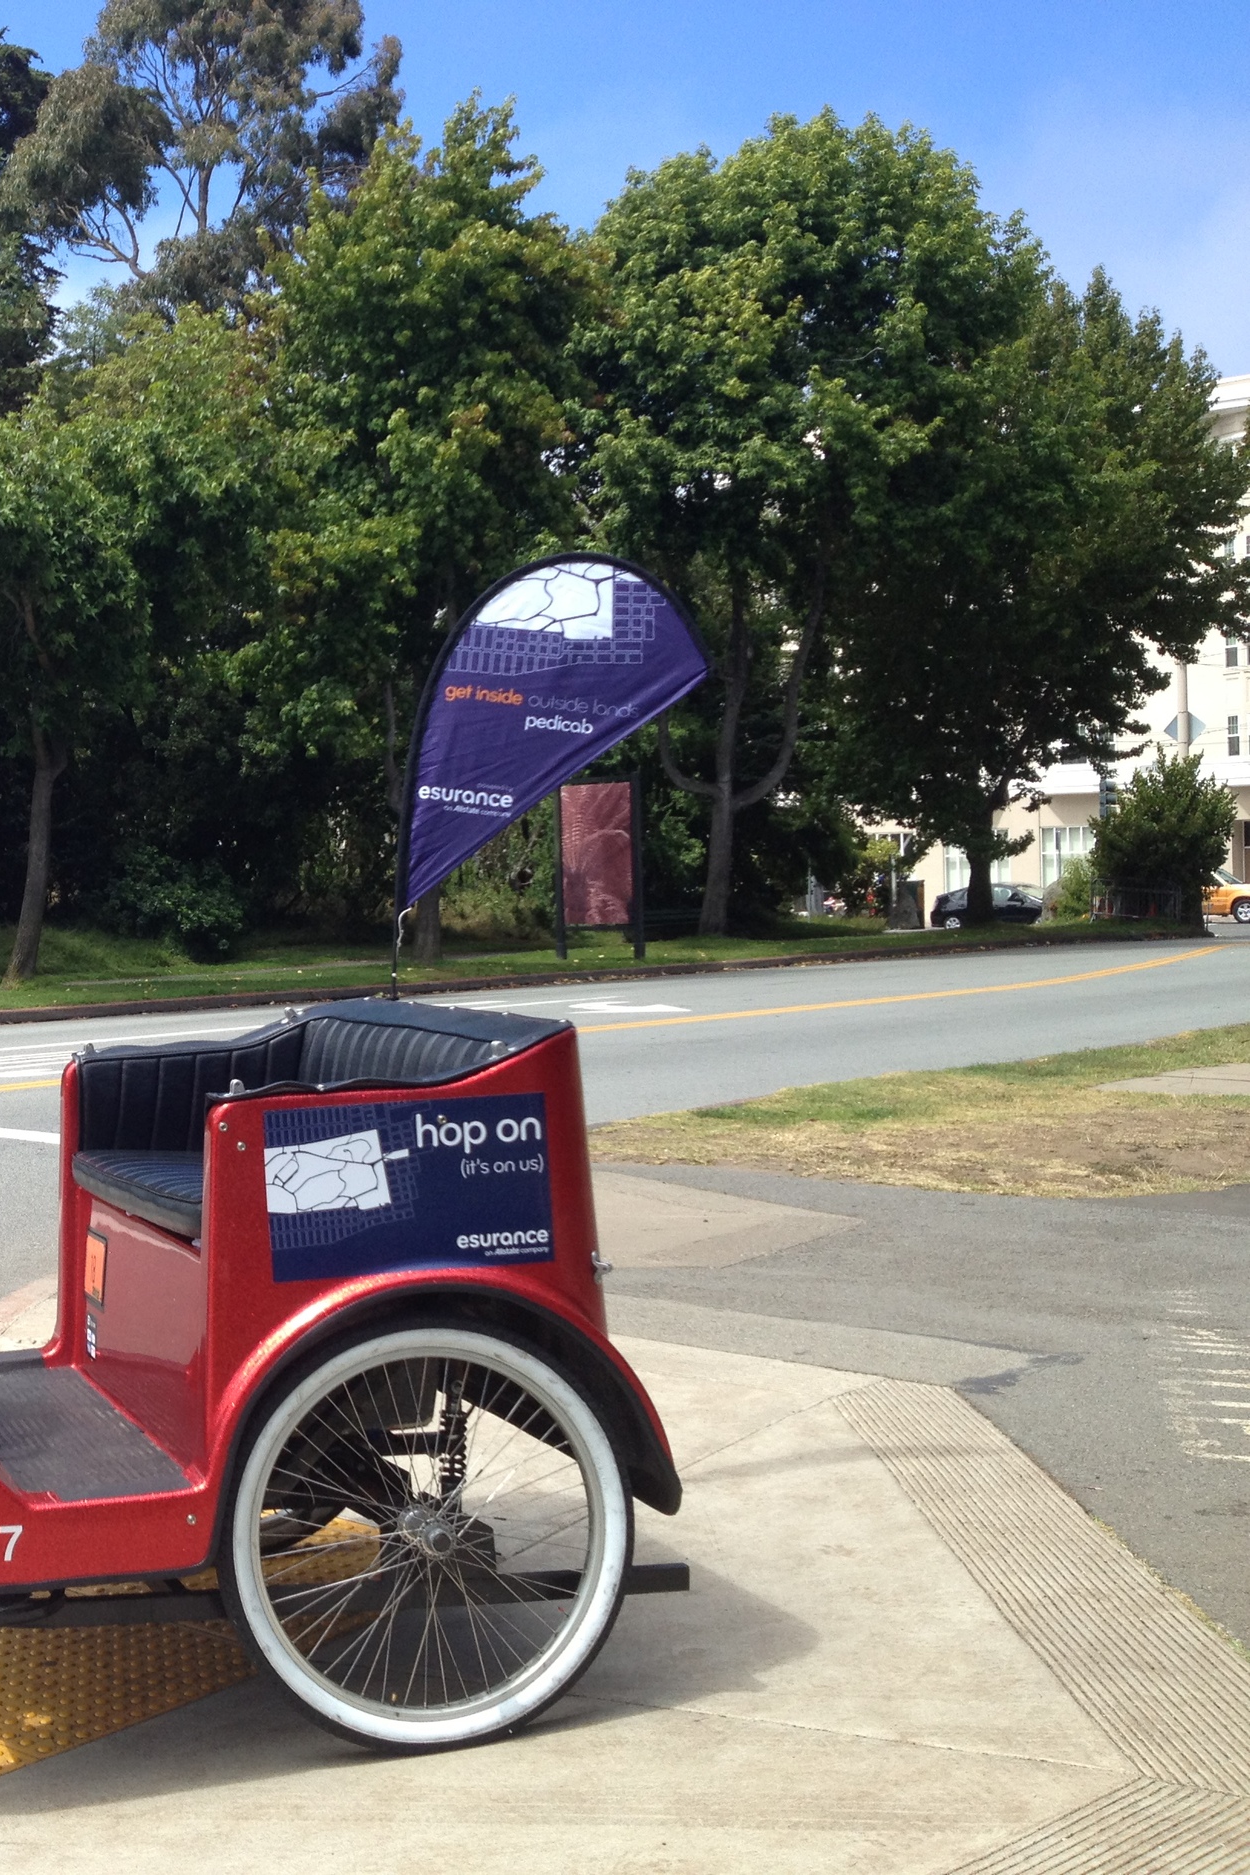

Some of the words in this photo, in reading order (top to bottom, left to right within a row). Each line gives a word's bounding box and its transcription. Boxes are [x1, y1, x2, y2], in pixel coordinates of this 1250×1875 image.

[445, 686, 472, 701] get
[475, 685, 524, 706] inside
[527, 695, 589, 714] outside
[592, 699, 640, 718] lands
[524, 715, 594, 734] pedicab
[418, 785, 513, 808] esurance
[415, 1113, 487, 1154] hop
[496, 1117, 542, 1141] on
[460, 1158, 490, 1179] (it's
[493, 1161, 516, 1173] on
[519, 1153, 544, 1173] us)
[456, 1229, 549, 1249] esurance
